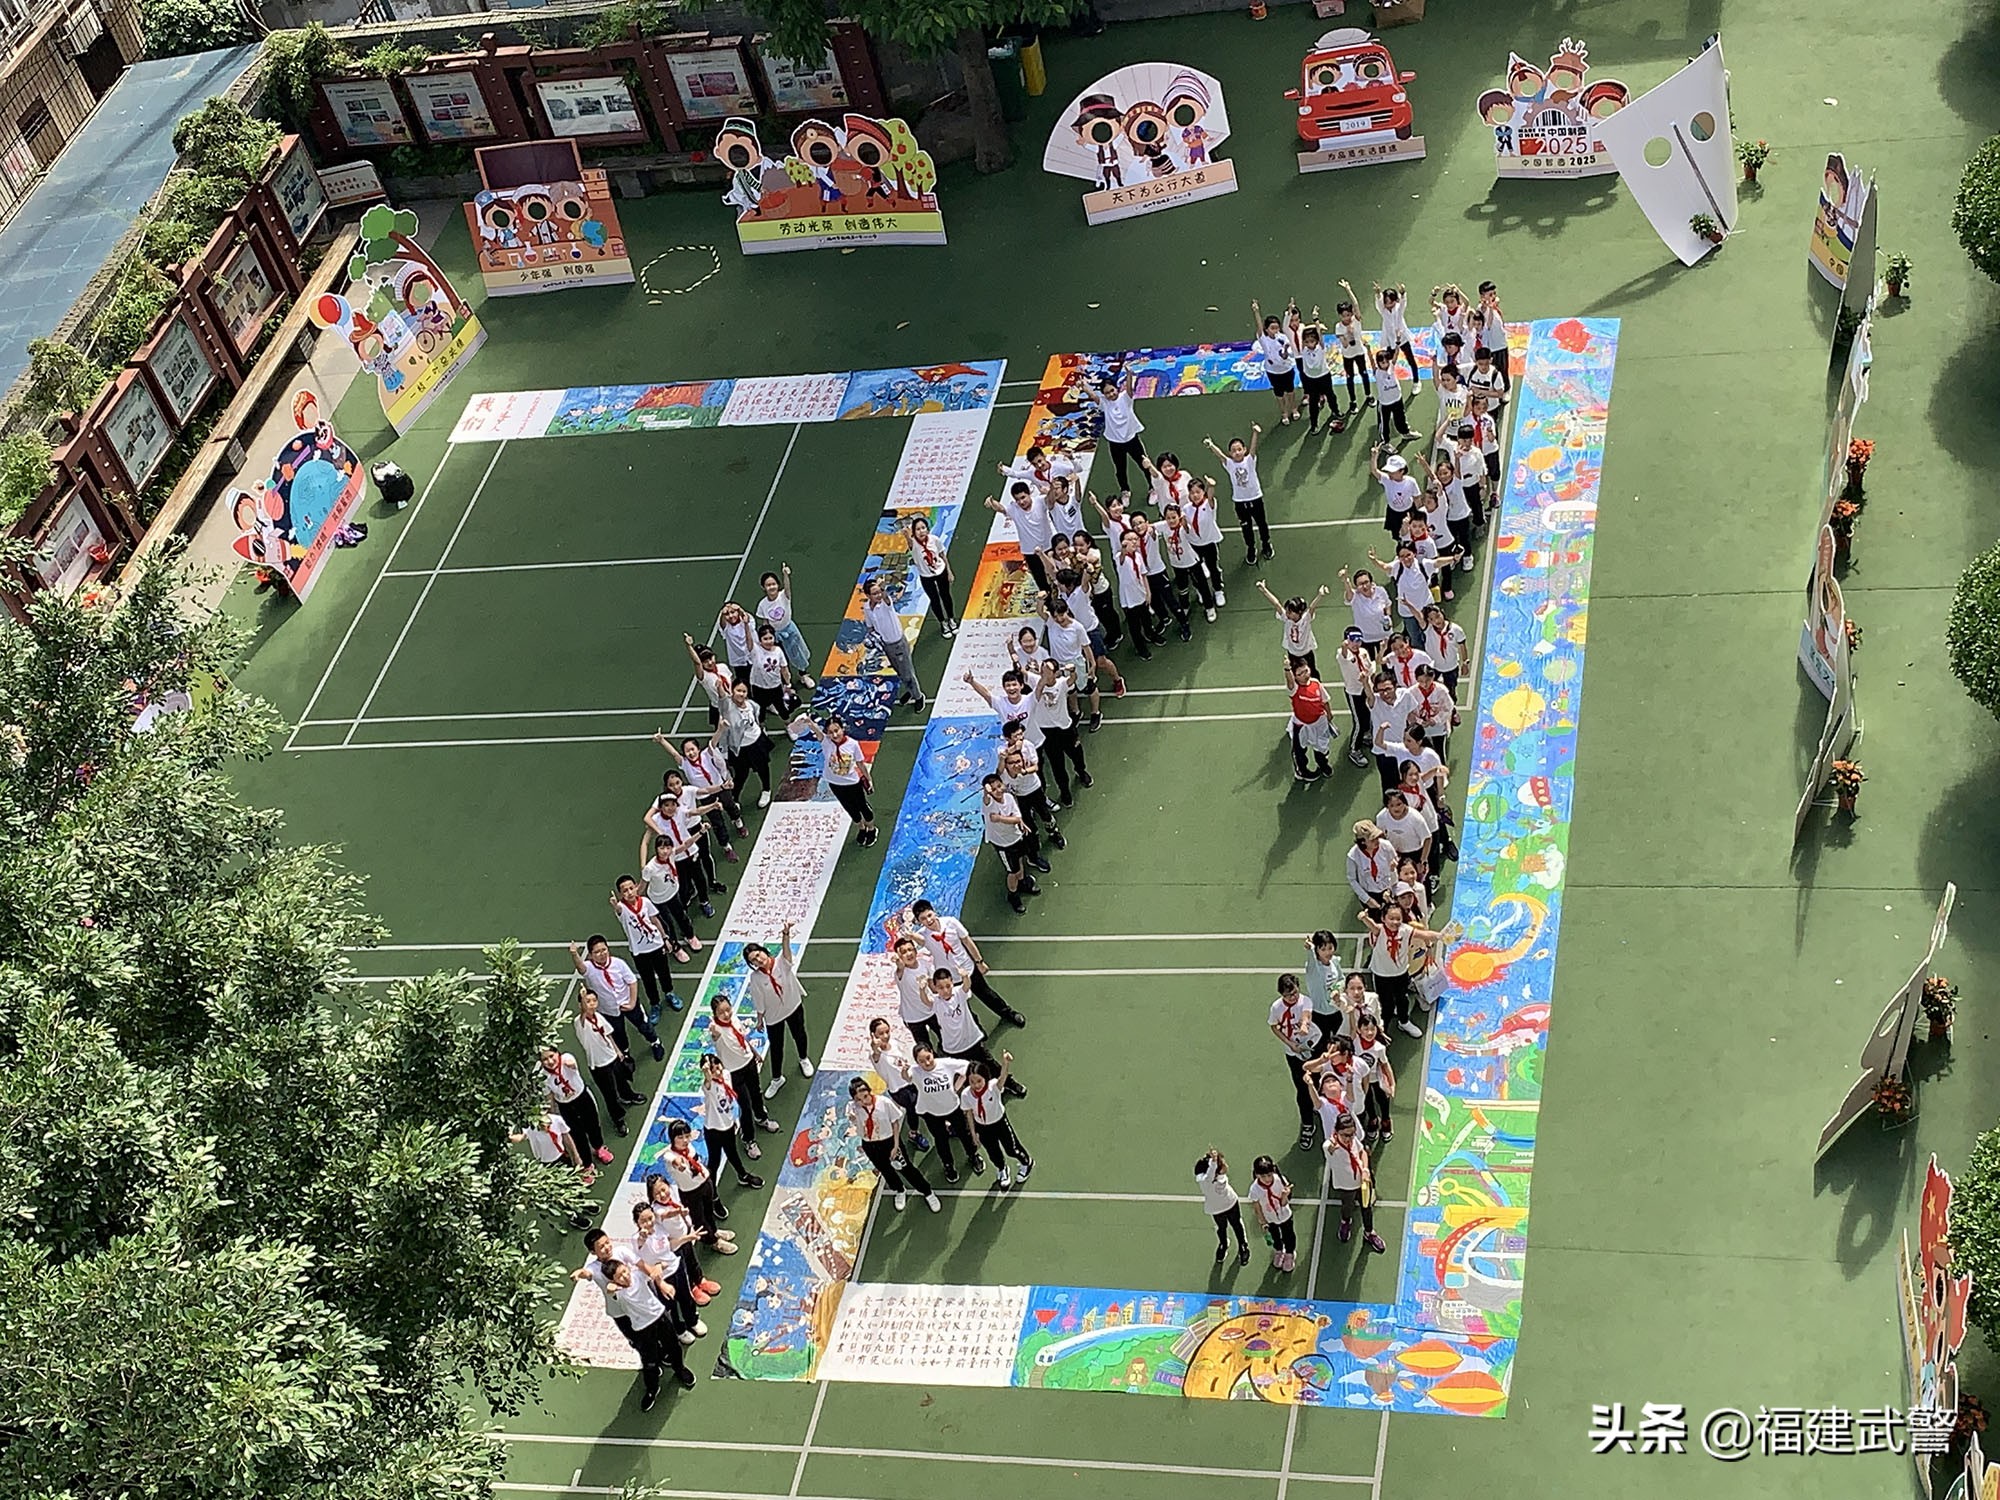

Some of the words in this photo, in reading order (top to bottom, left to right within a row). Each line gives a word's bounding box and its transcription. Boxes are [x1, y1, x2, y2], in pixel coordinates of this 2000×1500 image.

[1345, 120, 1366, 129] 2019
[1548, 126, 1587, 136] 中国制造
[1535, 137, 1588, 155] 2025
[1569, 155, 1596, 166] 2025
[1112, 171, 1206, 204] 天下为公行大道
[779, 220, 834, 235] 劳动光荣
[844, 217, 898, 230] 创造伟大
[520, 268, 553, 282] 少年强
[563, 264, 596, 275] 则国强
[923, 1074, 949, 1085] GIRLS
[924, 1083, 950, 1093] UNITE
